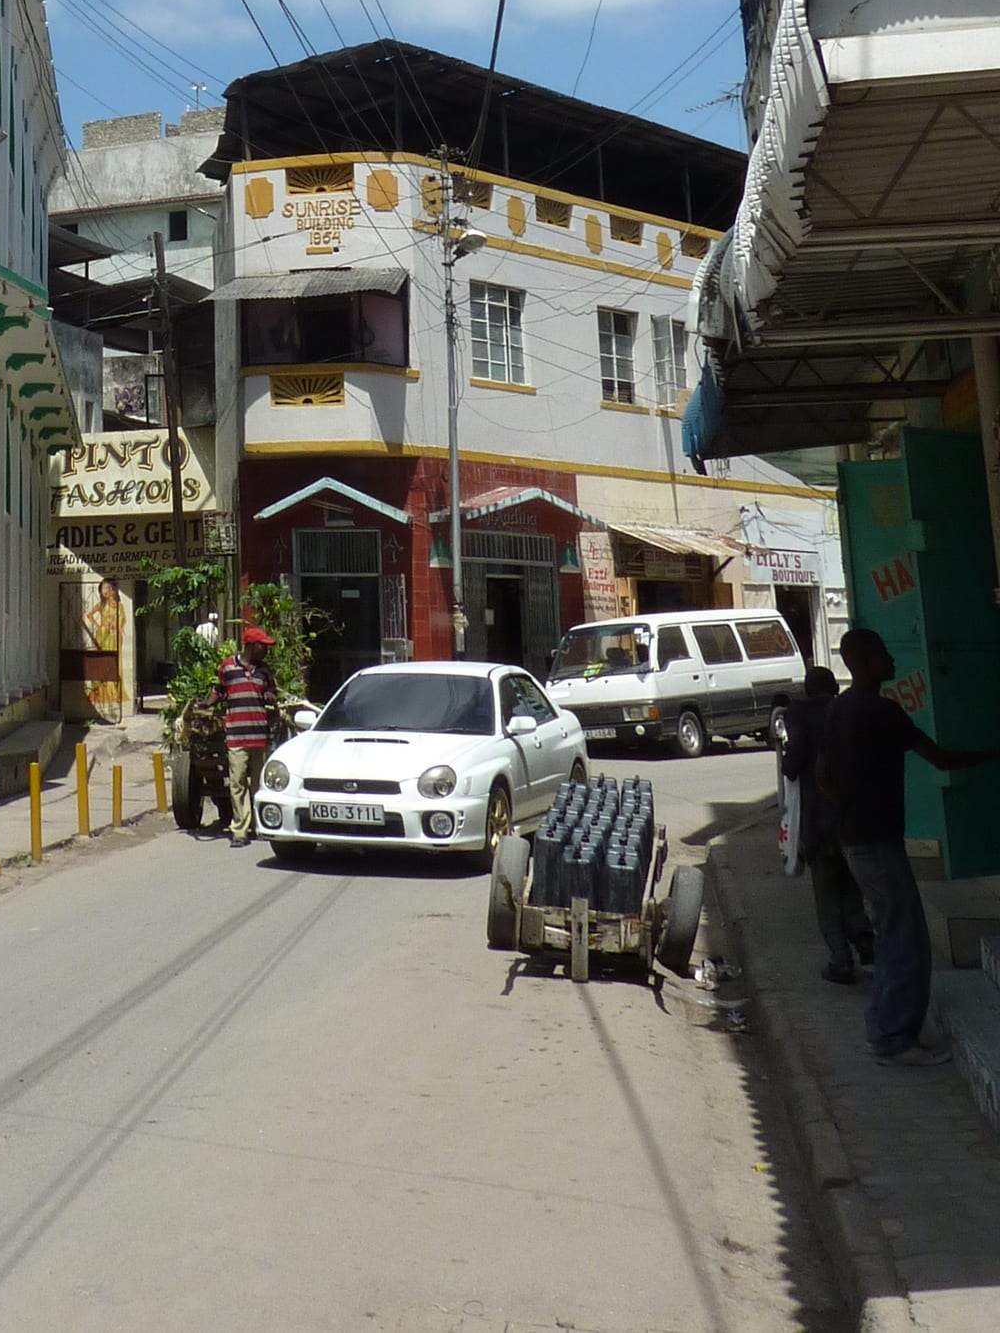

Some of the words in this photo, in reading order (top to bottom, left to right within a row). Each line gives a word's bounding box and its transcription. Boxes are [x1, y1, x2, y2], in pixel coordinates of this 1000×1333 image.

[281, 198, 362, 219] SUNRISE
[296, 217, 355, 231] BUILDING
[61, 434, 190, 478] PINTO
[122, 523, 139, 545] &
[49, 552, 108, 566] READYMADE
[772, 570, 816, 584] BOUTIQUE
[311, 804, 338, 819] KBG
[344, 805, 382, 822] 311L
